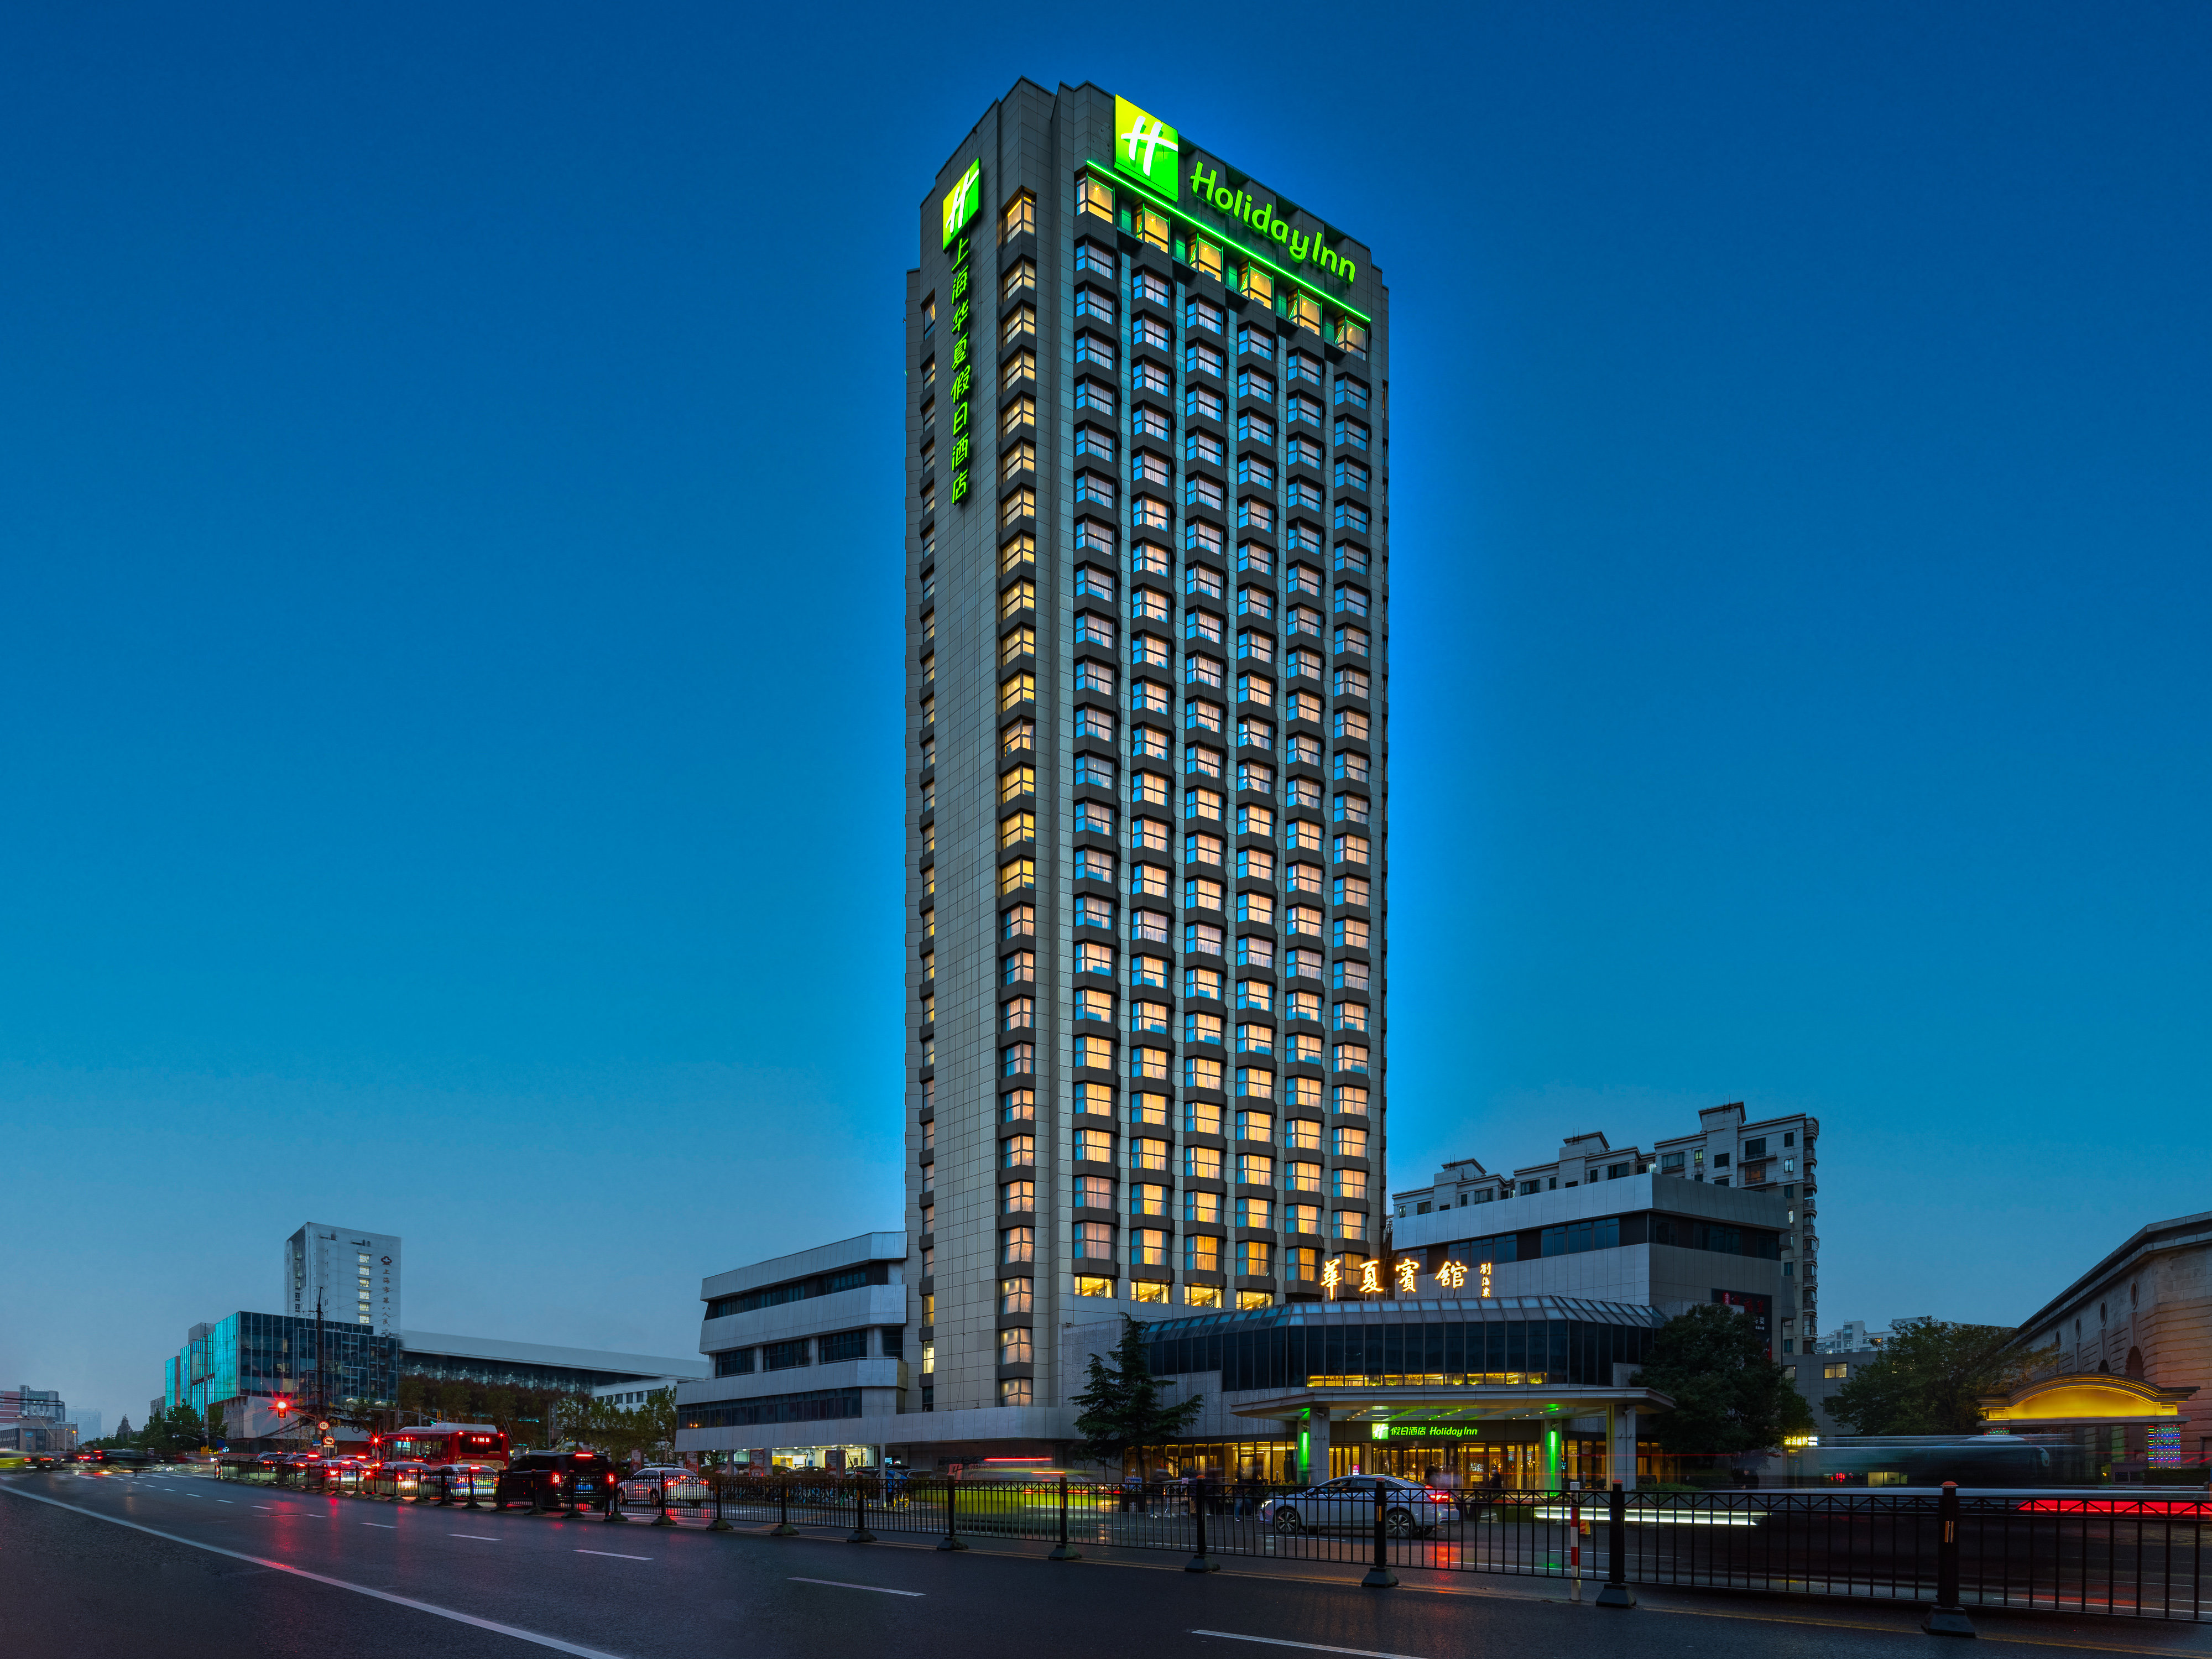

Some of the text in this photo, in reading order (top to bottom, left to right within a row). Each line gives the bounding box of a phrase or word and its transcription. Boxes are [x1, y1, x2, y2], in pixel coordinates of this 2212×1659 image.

[1190, 161, 1355, 284] Holiday Inn
[951, 237, 971, 504] 上海华夏假日酒店
[1390, 1426, 1478, 1437] 假日酒店 Holiday Inn
